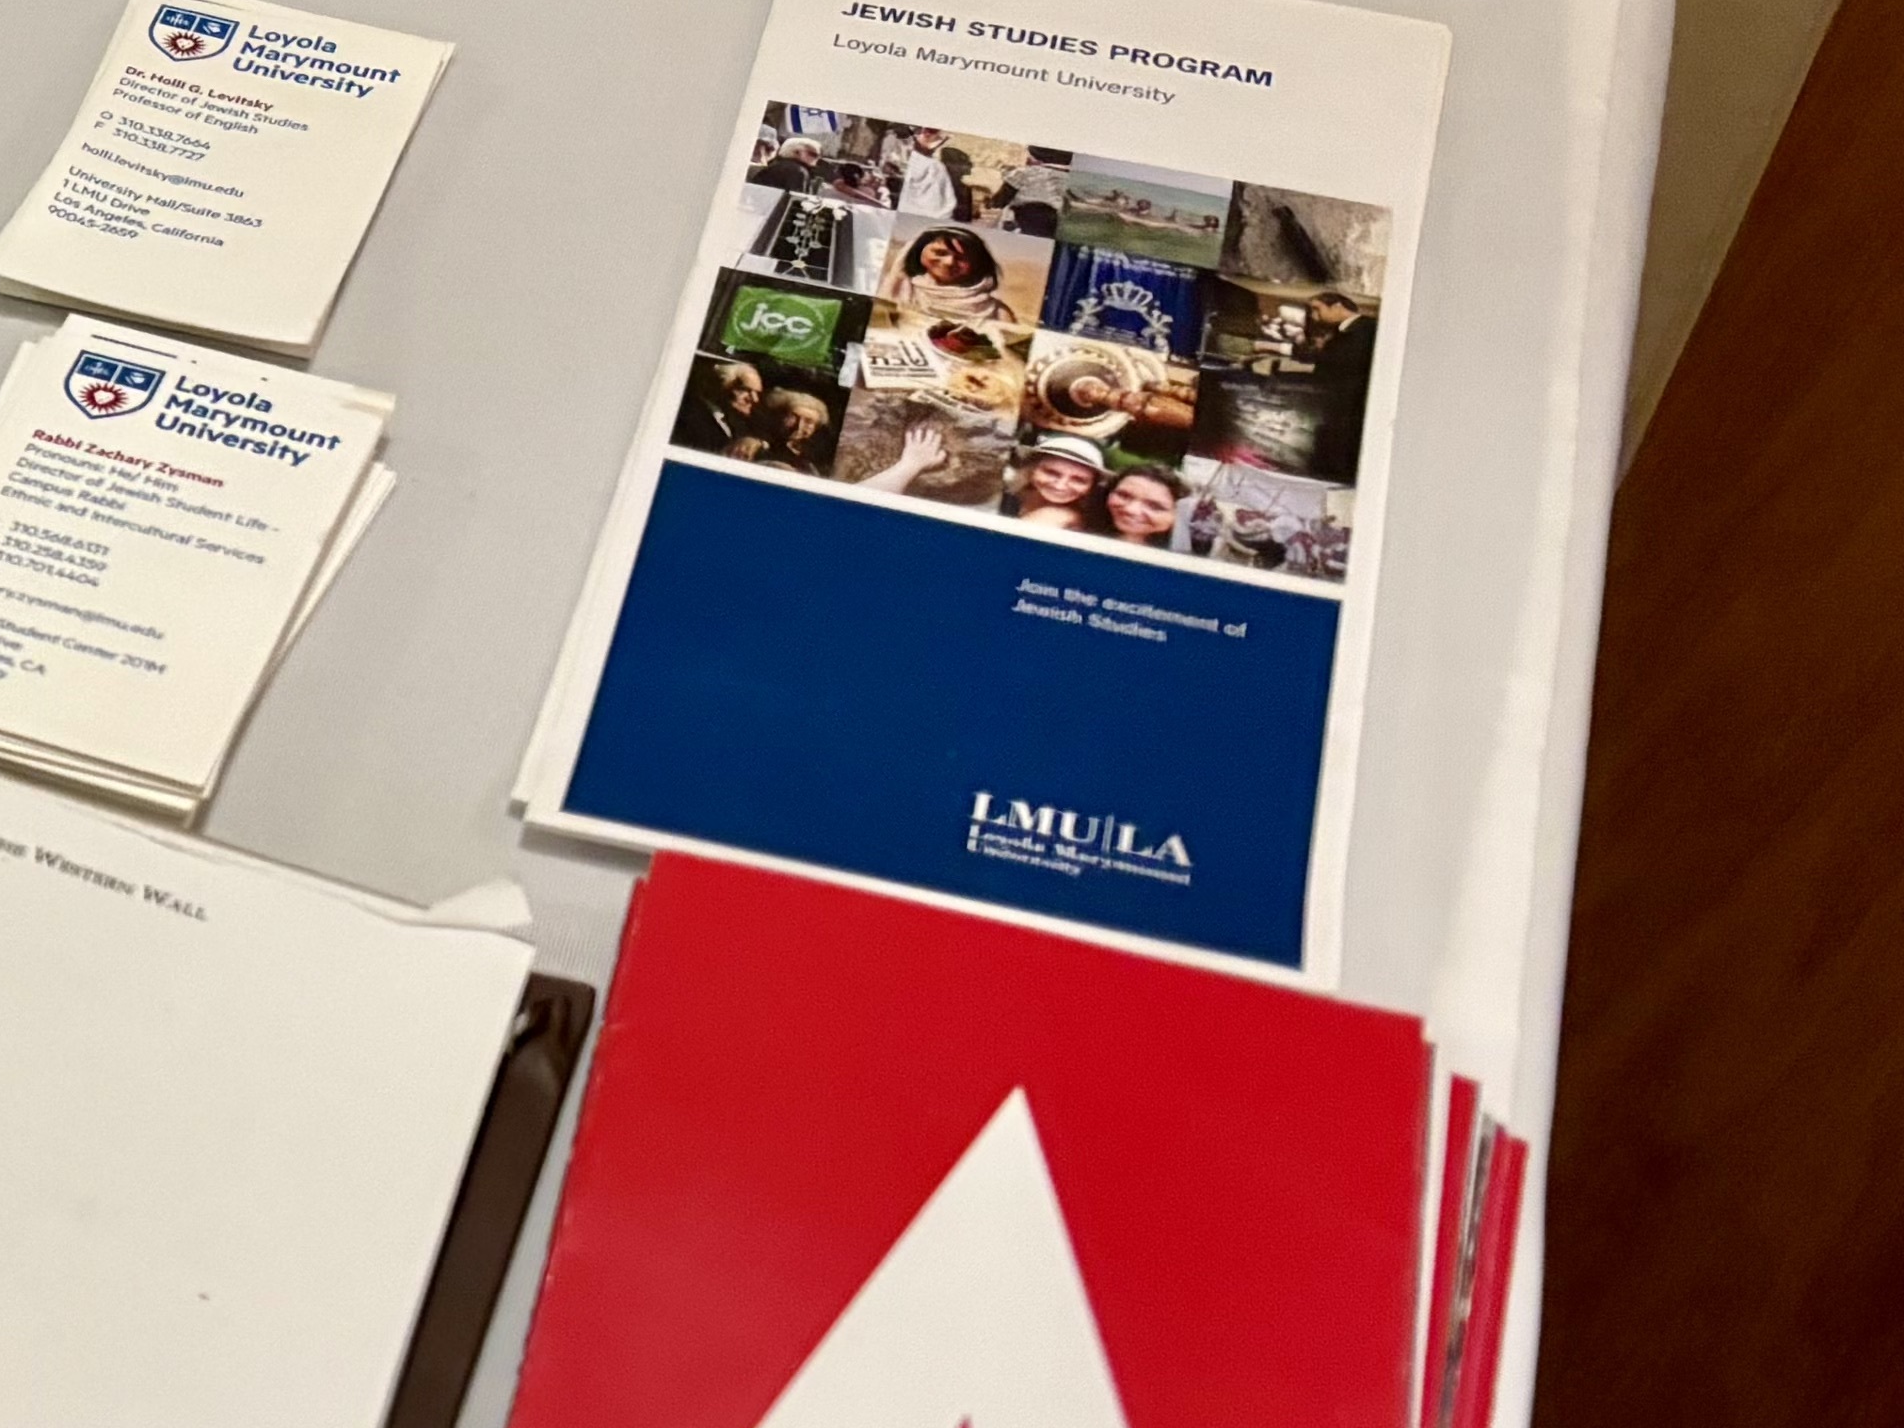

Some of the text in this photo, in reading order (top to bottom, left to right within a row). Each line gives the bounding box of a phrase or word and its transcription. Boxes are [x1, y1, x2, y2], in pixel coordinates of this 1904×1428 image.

[240, 41, 399, 82] Marymount
[248, 24, 336, 53] Loyola
[842, 2, 1272, 85] JEWISH STUDIES PROGRAM
[124, 65, 273, 112] Dr. Holli G. Levitsky
[232, 57, 372, 97] University
[833, 33, 1175, 104] Loyola Marymount University
[112, 87, 258, 134] Professor of English
[118, 76, 308, 131] Director of Jewish Studies
[53, 191, 81, 209] Los
[151, 223, 224, 246] California
[70, 182, 108, 203] LMU
[109, 197, 150, 215] Drive
[175, 375, 272, 412] Loyola
[155, 412, 309, 466] University
[165, 394, 339, 449] Marymount
[32, 428, 223, 487] Rabbi Zachary Zysman
